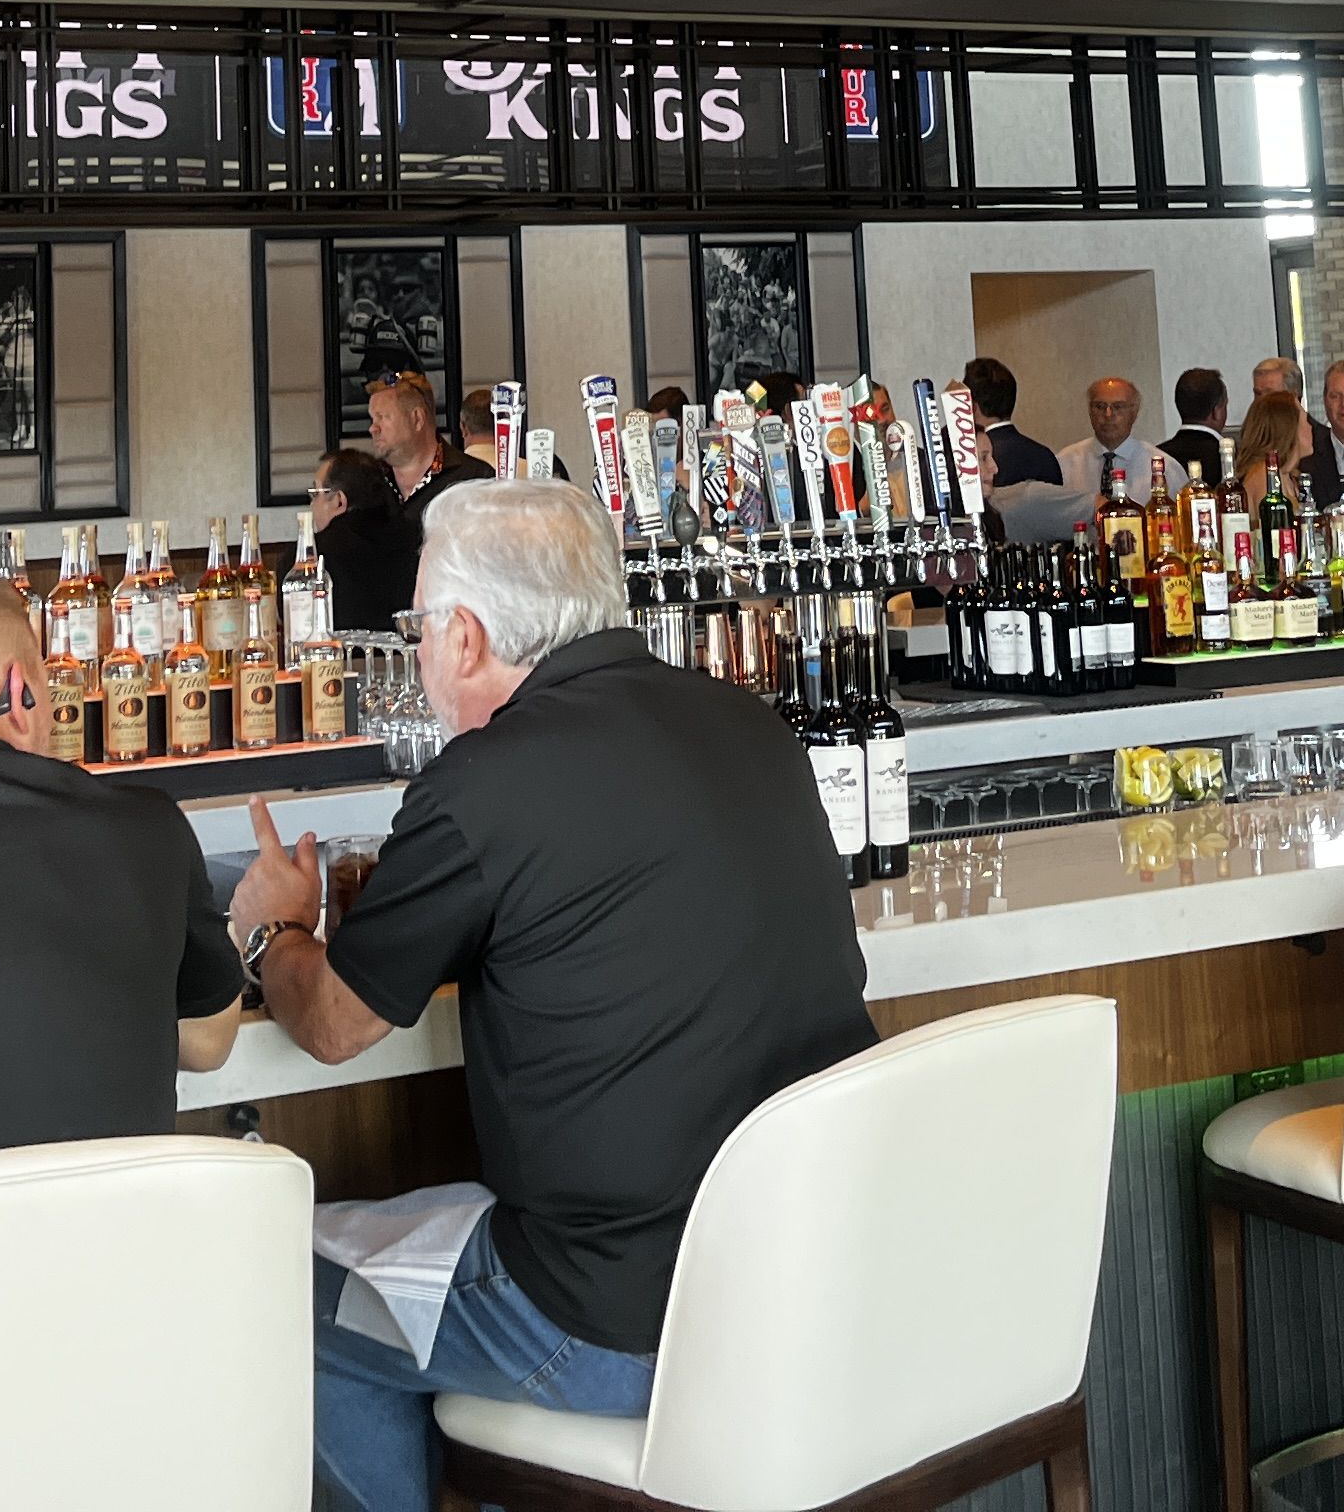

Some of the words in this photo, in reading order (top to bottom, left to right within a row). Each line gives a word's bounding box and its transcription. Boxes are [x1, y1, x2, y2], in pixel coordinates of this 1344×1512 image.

[798, 405, 819, 464] 805
[925, 396, 945, 452] LIGHT
[949, 391, 980, 478] Coors
[935, 452, 952, 495] BUD
